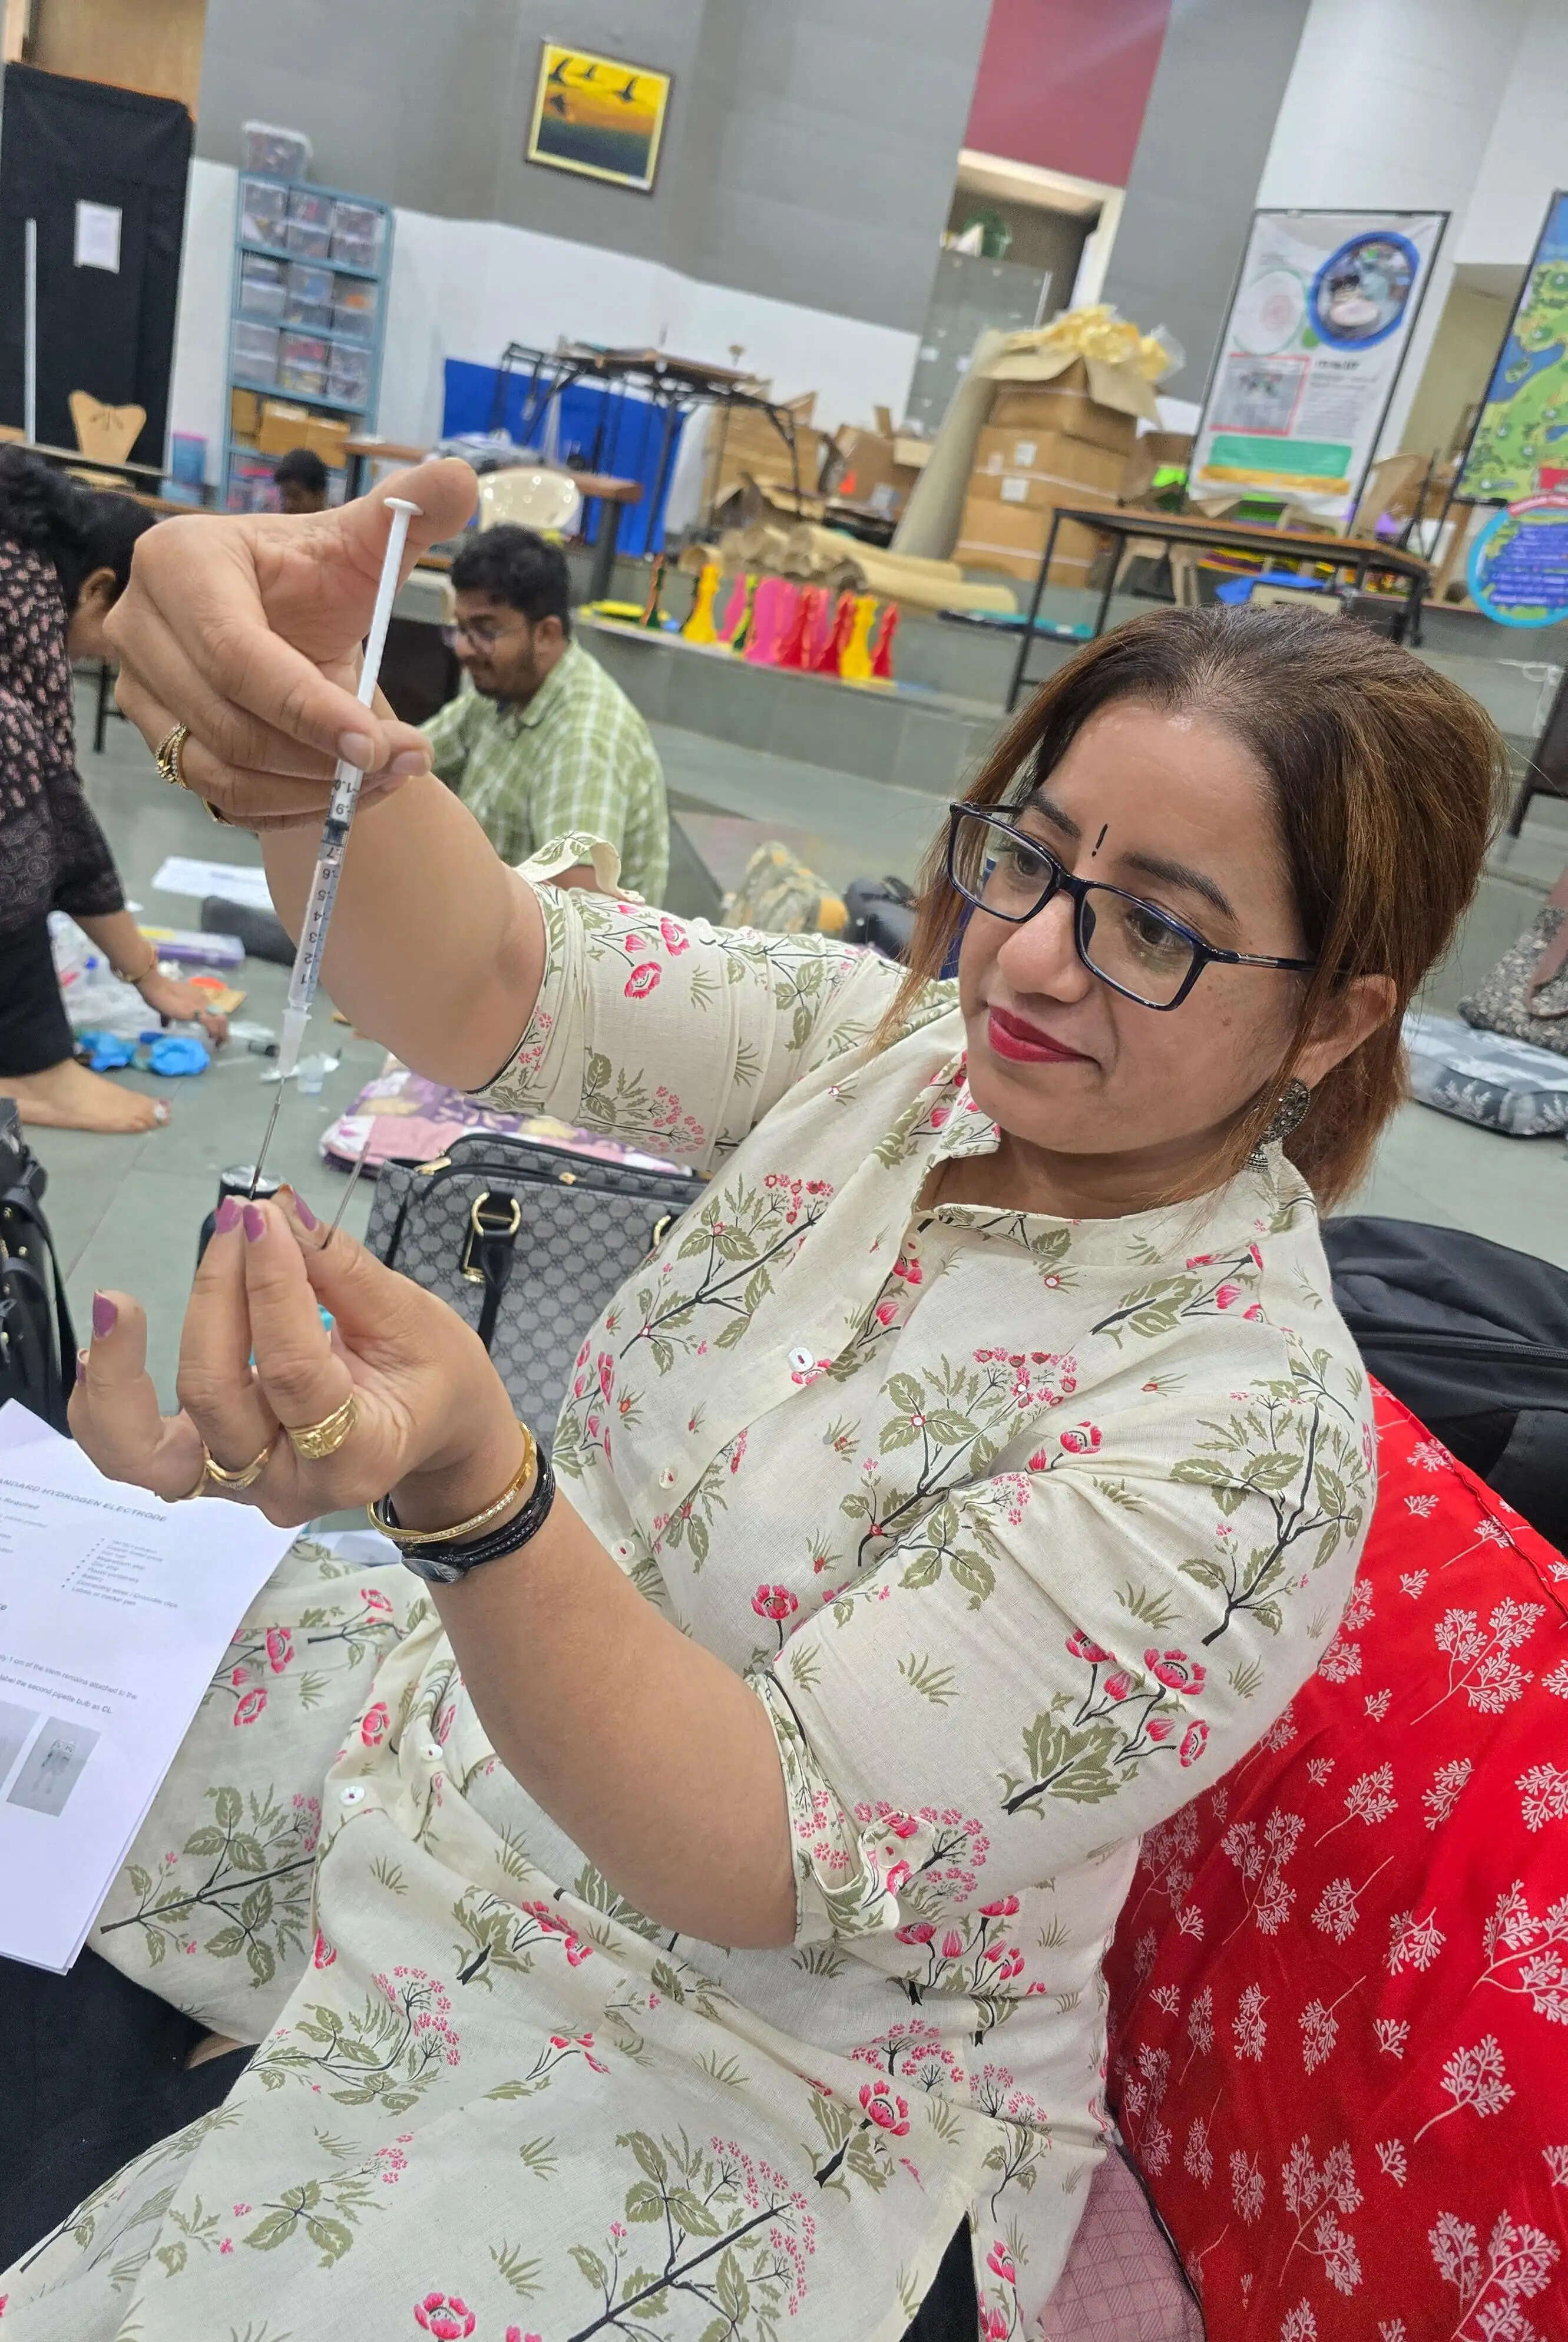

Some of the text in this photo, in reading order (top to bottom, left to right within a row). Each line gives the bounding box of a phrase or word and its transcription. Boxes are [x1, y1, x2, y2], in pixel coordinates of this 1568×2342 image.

[42, 1488, 101, 1506] HYDROGEN
[103, 1503, 168, 1522] ELECTRODE
[28, 1683, 53, 1695] second
